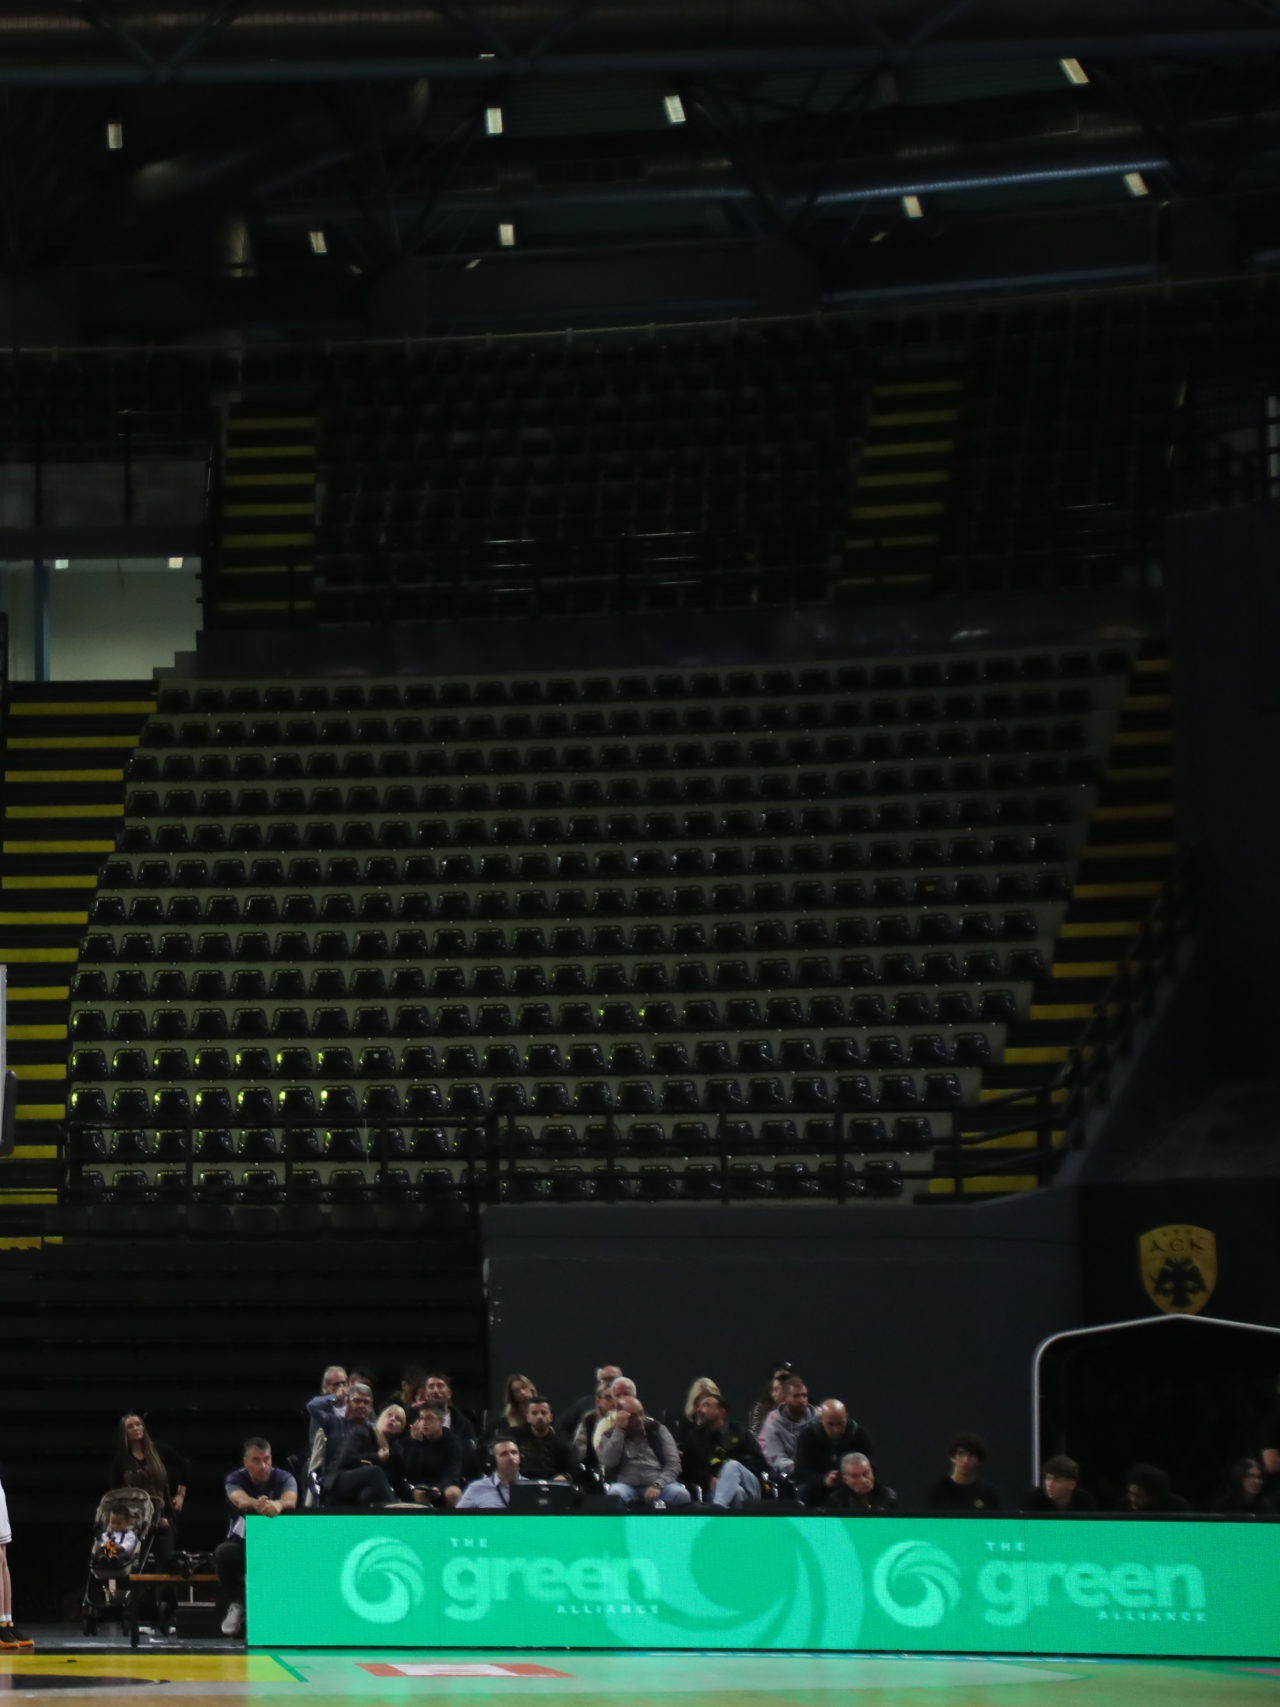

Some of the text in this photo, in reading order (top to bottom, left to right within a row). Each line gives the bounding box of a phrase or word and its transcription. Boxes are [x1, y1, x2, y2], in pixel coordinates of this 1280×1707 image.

[449, 1537, 488, 1548] THE
[985, 1541, 1025, 1552] THE
[441, 1555, 660, 1621] green
[977, 1560, 1206, 1626] green
[1098, 1610, 1207, 1622] ALLIANCE
